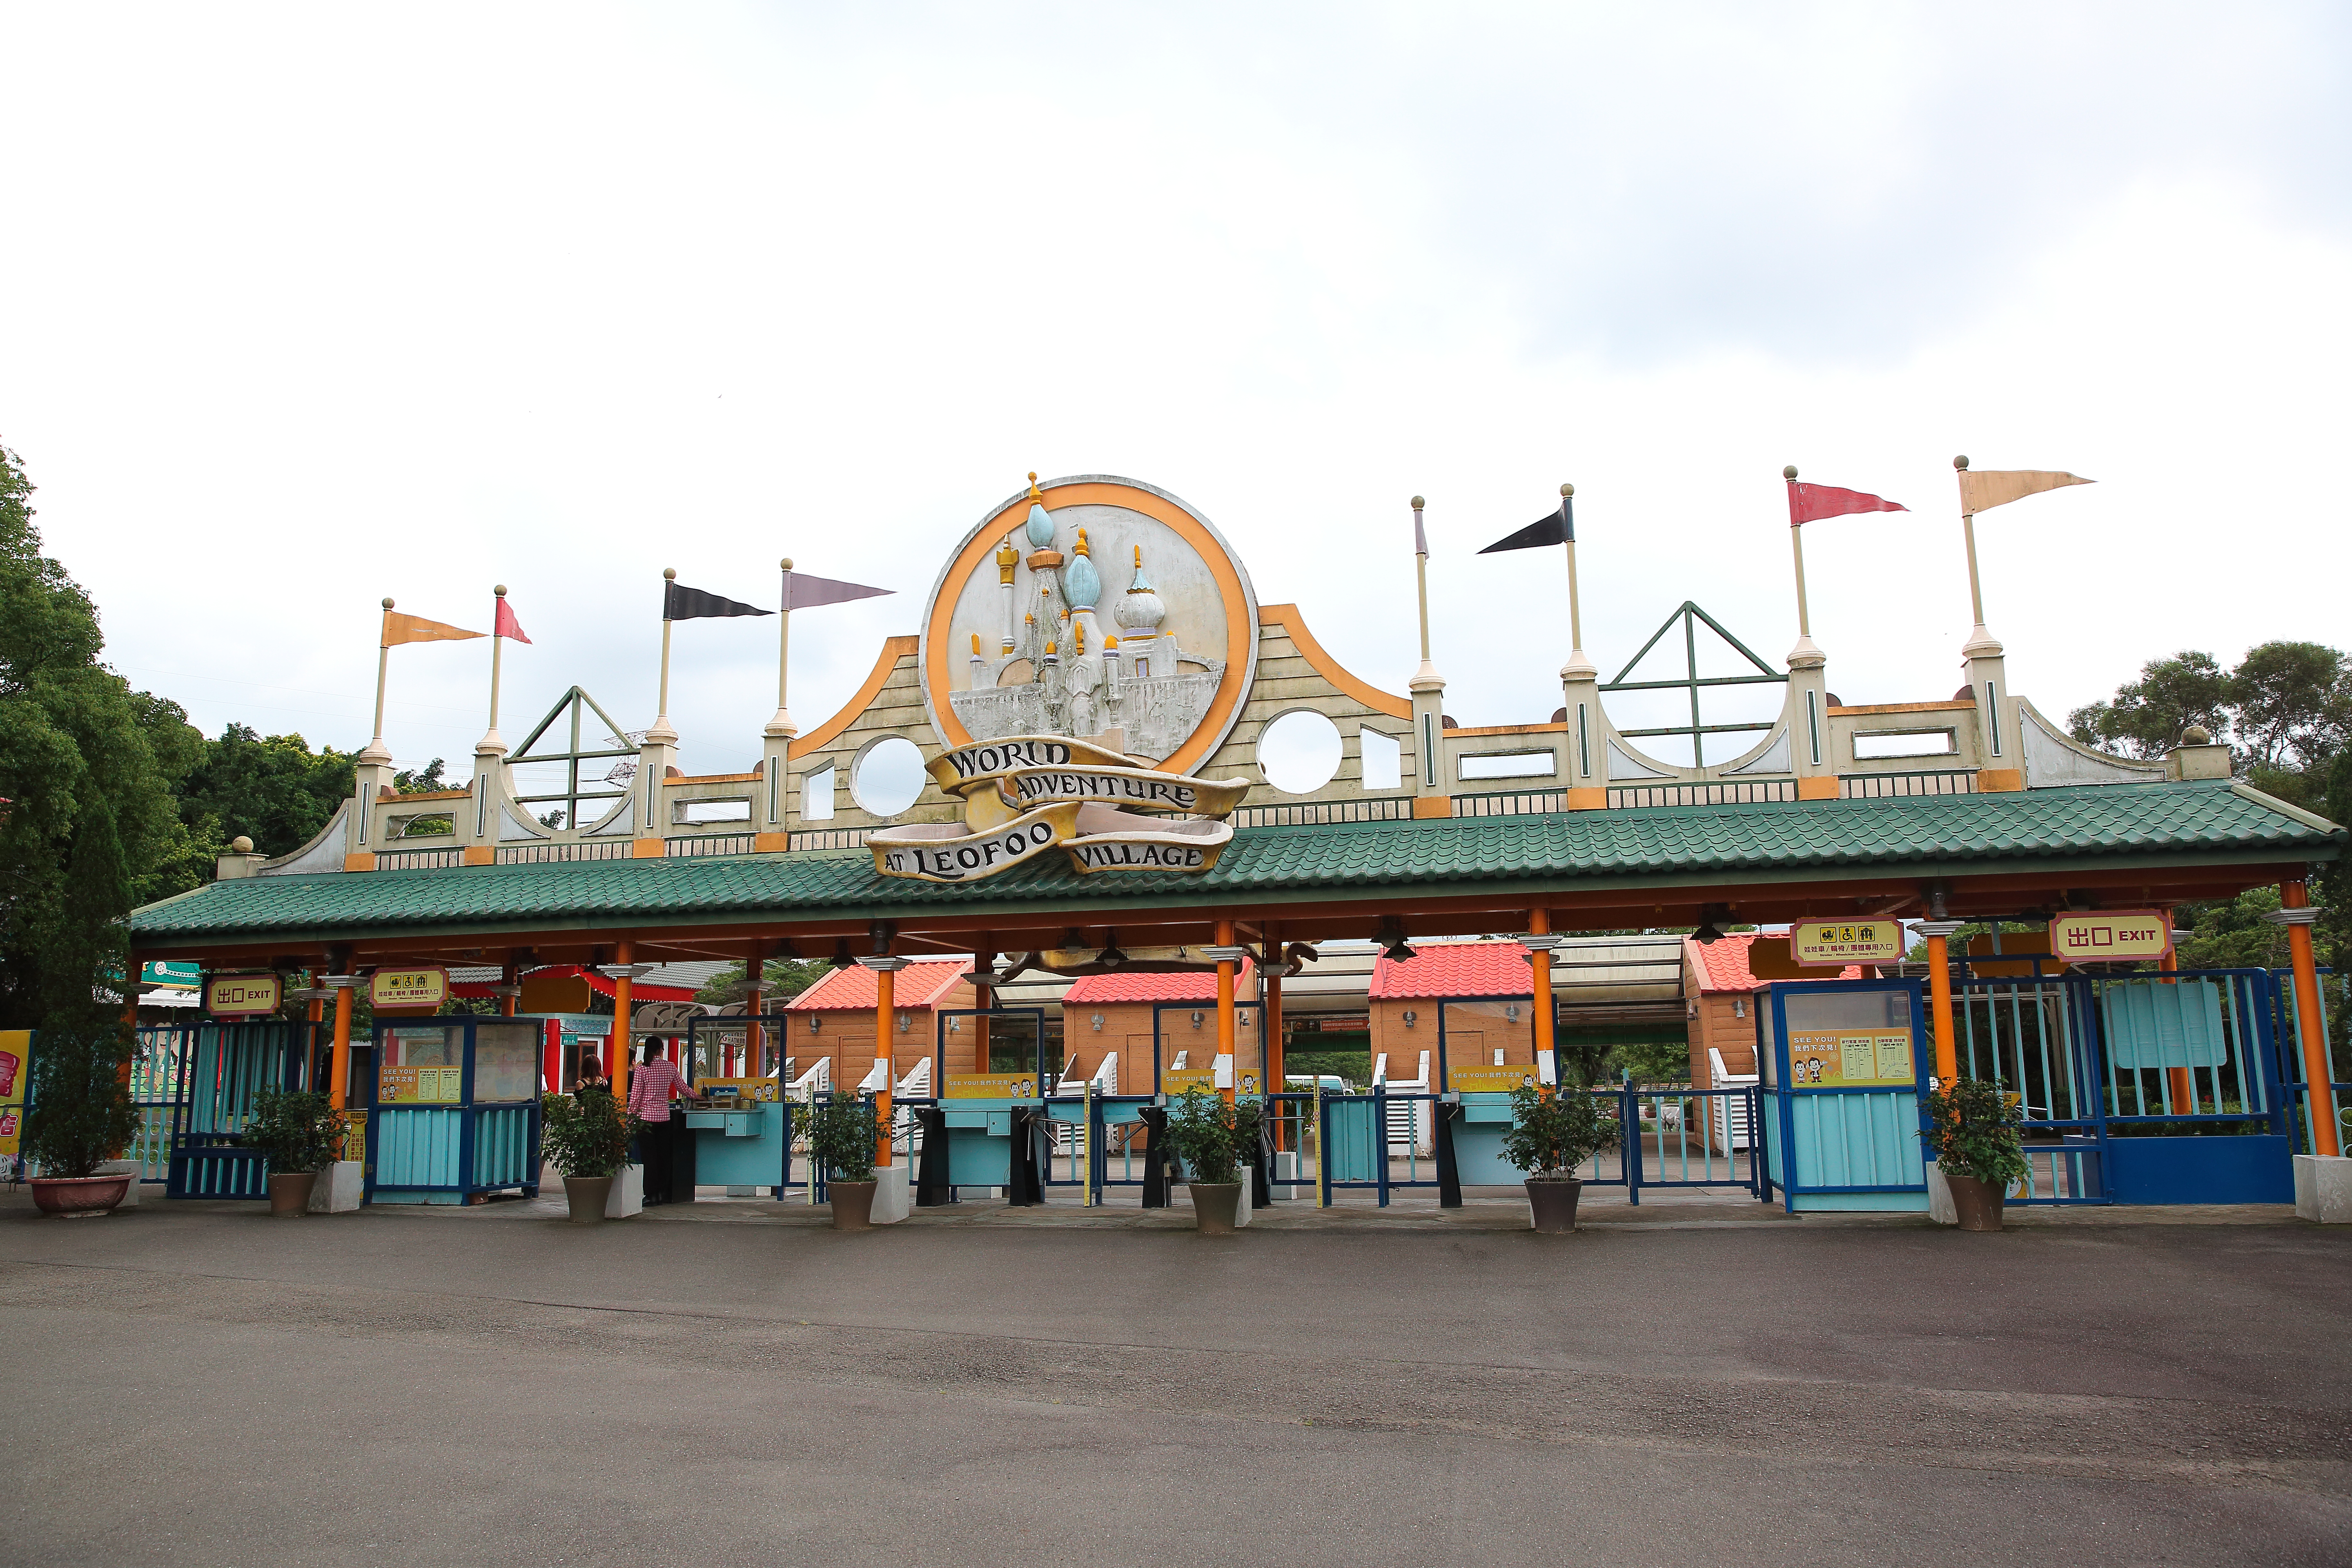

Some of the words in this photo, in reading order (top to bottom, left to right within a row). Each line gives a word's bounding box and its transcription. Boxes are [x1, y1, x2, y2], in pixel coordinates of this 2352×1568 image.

[944, 742, 1071, 779] WORLD
[1014, 774, 1197, 809] ADVENTURE
[885, 854, 904, 872] AT
[913, 822, 1052, 880] LEOFOO
[1071, 844, 1203, 868] VILLAGE
[2068, 927, 2113, 947] 出口
[2119, 930, 2156, 941] EXIT
[218, 988, 245, 1003] 出口
[248, 990, 270, 999] EXIT
